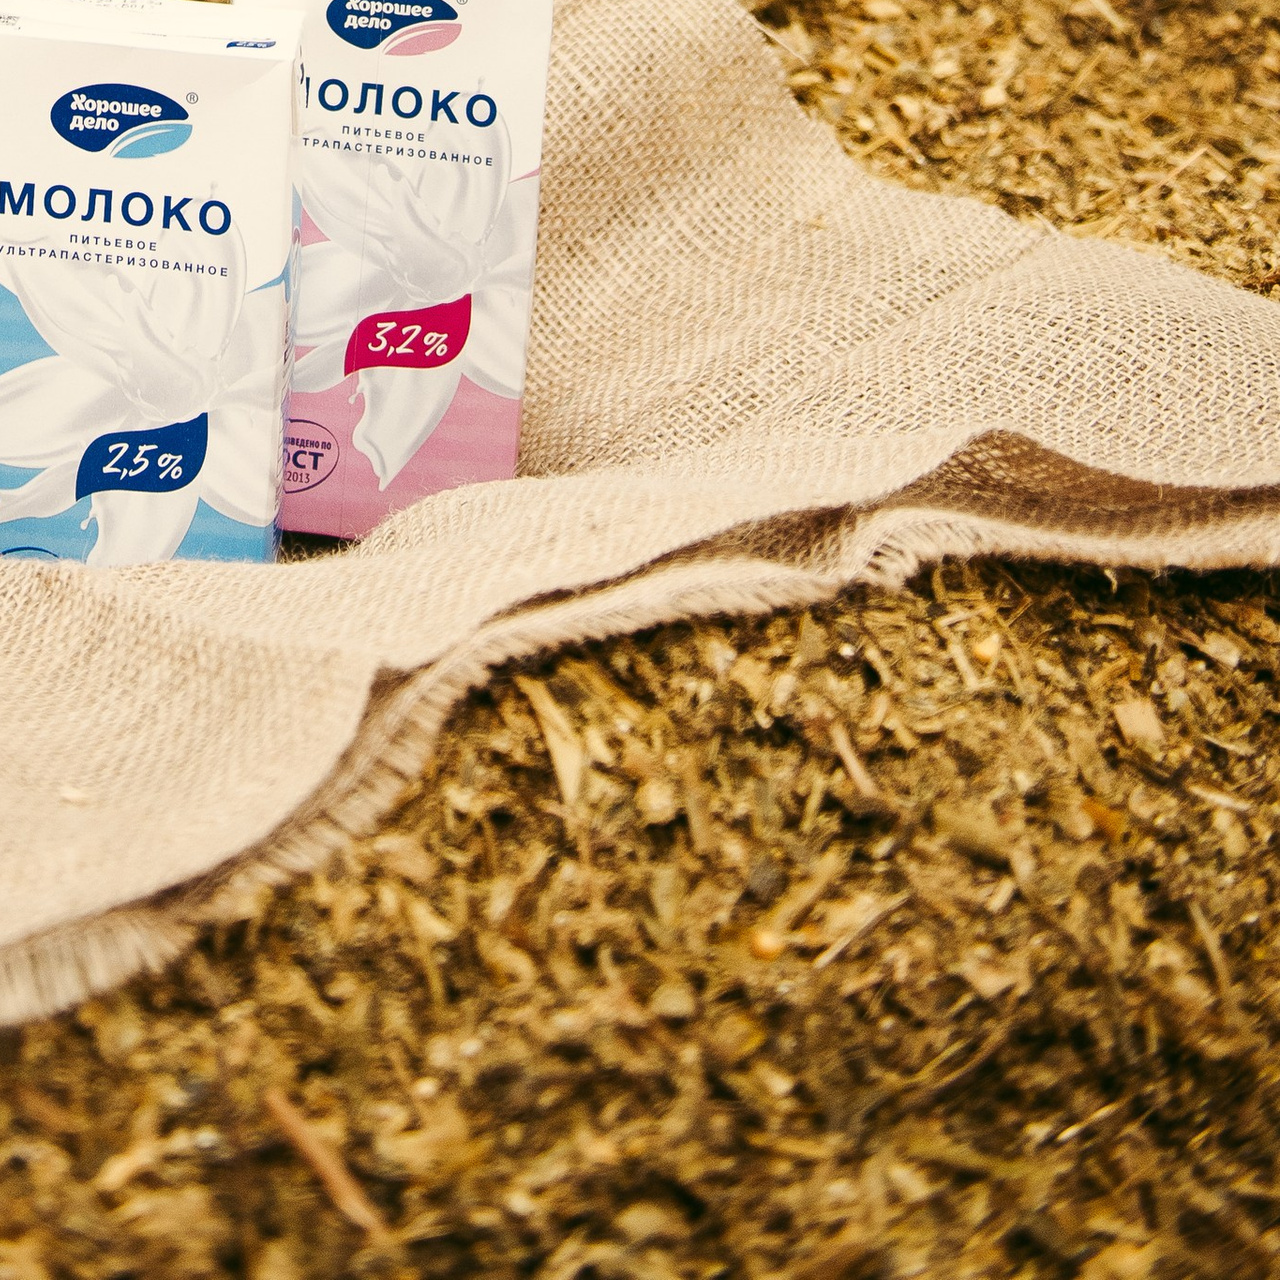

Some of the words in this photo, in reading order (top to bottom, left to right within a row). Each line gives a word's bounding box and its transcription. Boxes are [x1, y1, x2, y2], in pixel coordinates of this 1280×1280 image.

[344, 15, 392, 30] дело
[70, 93, 162, 117] Хорошее
[69, 115, 119, 131] дело
[342, 125, 425, 142] ПИТЬЕВОЕ
[70, 234, 157, 251] ПИТЬЕВОЕ
[367, 321, 449, 358] 3,2%
[321, 441, 332, 450] ПО
[102, 442, 183, 480] 2,5%
